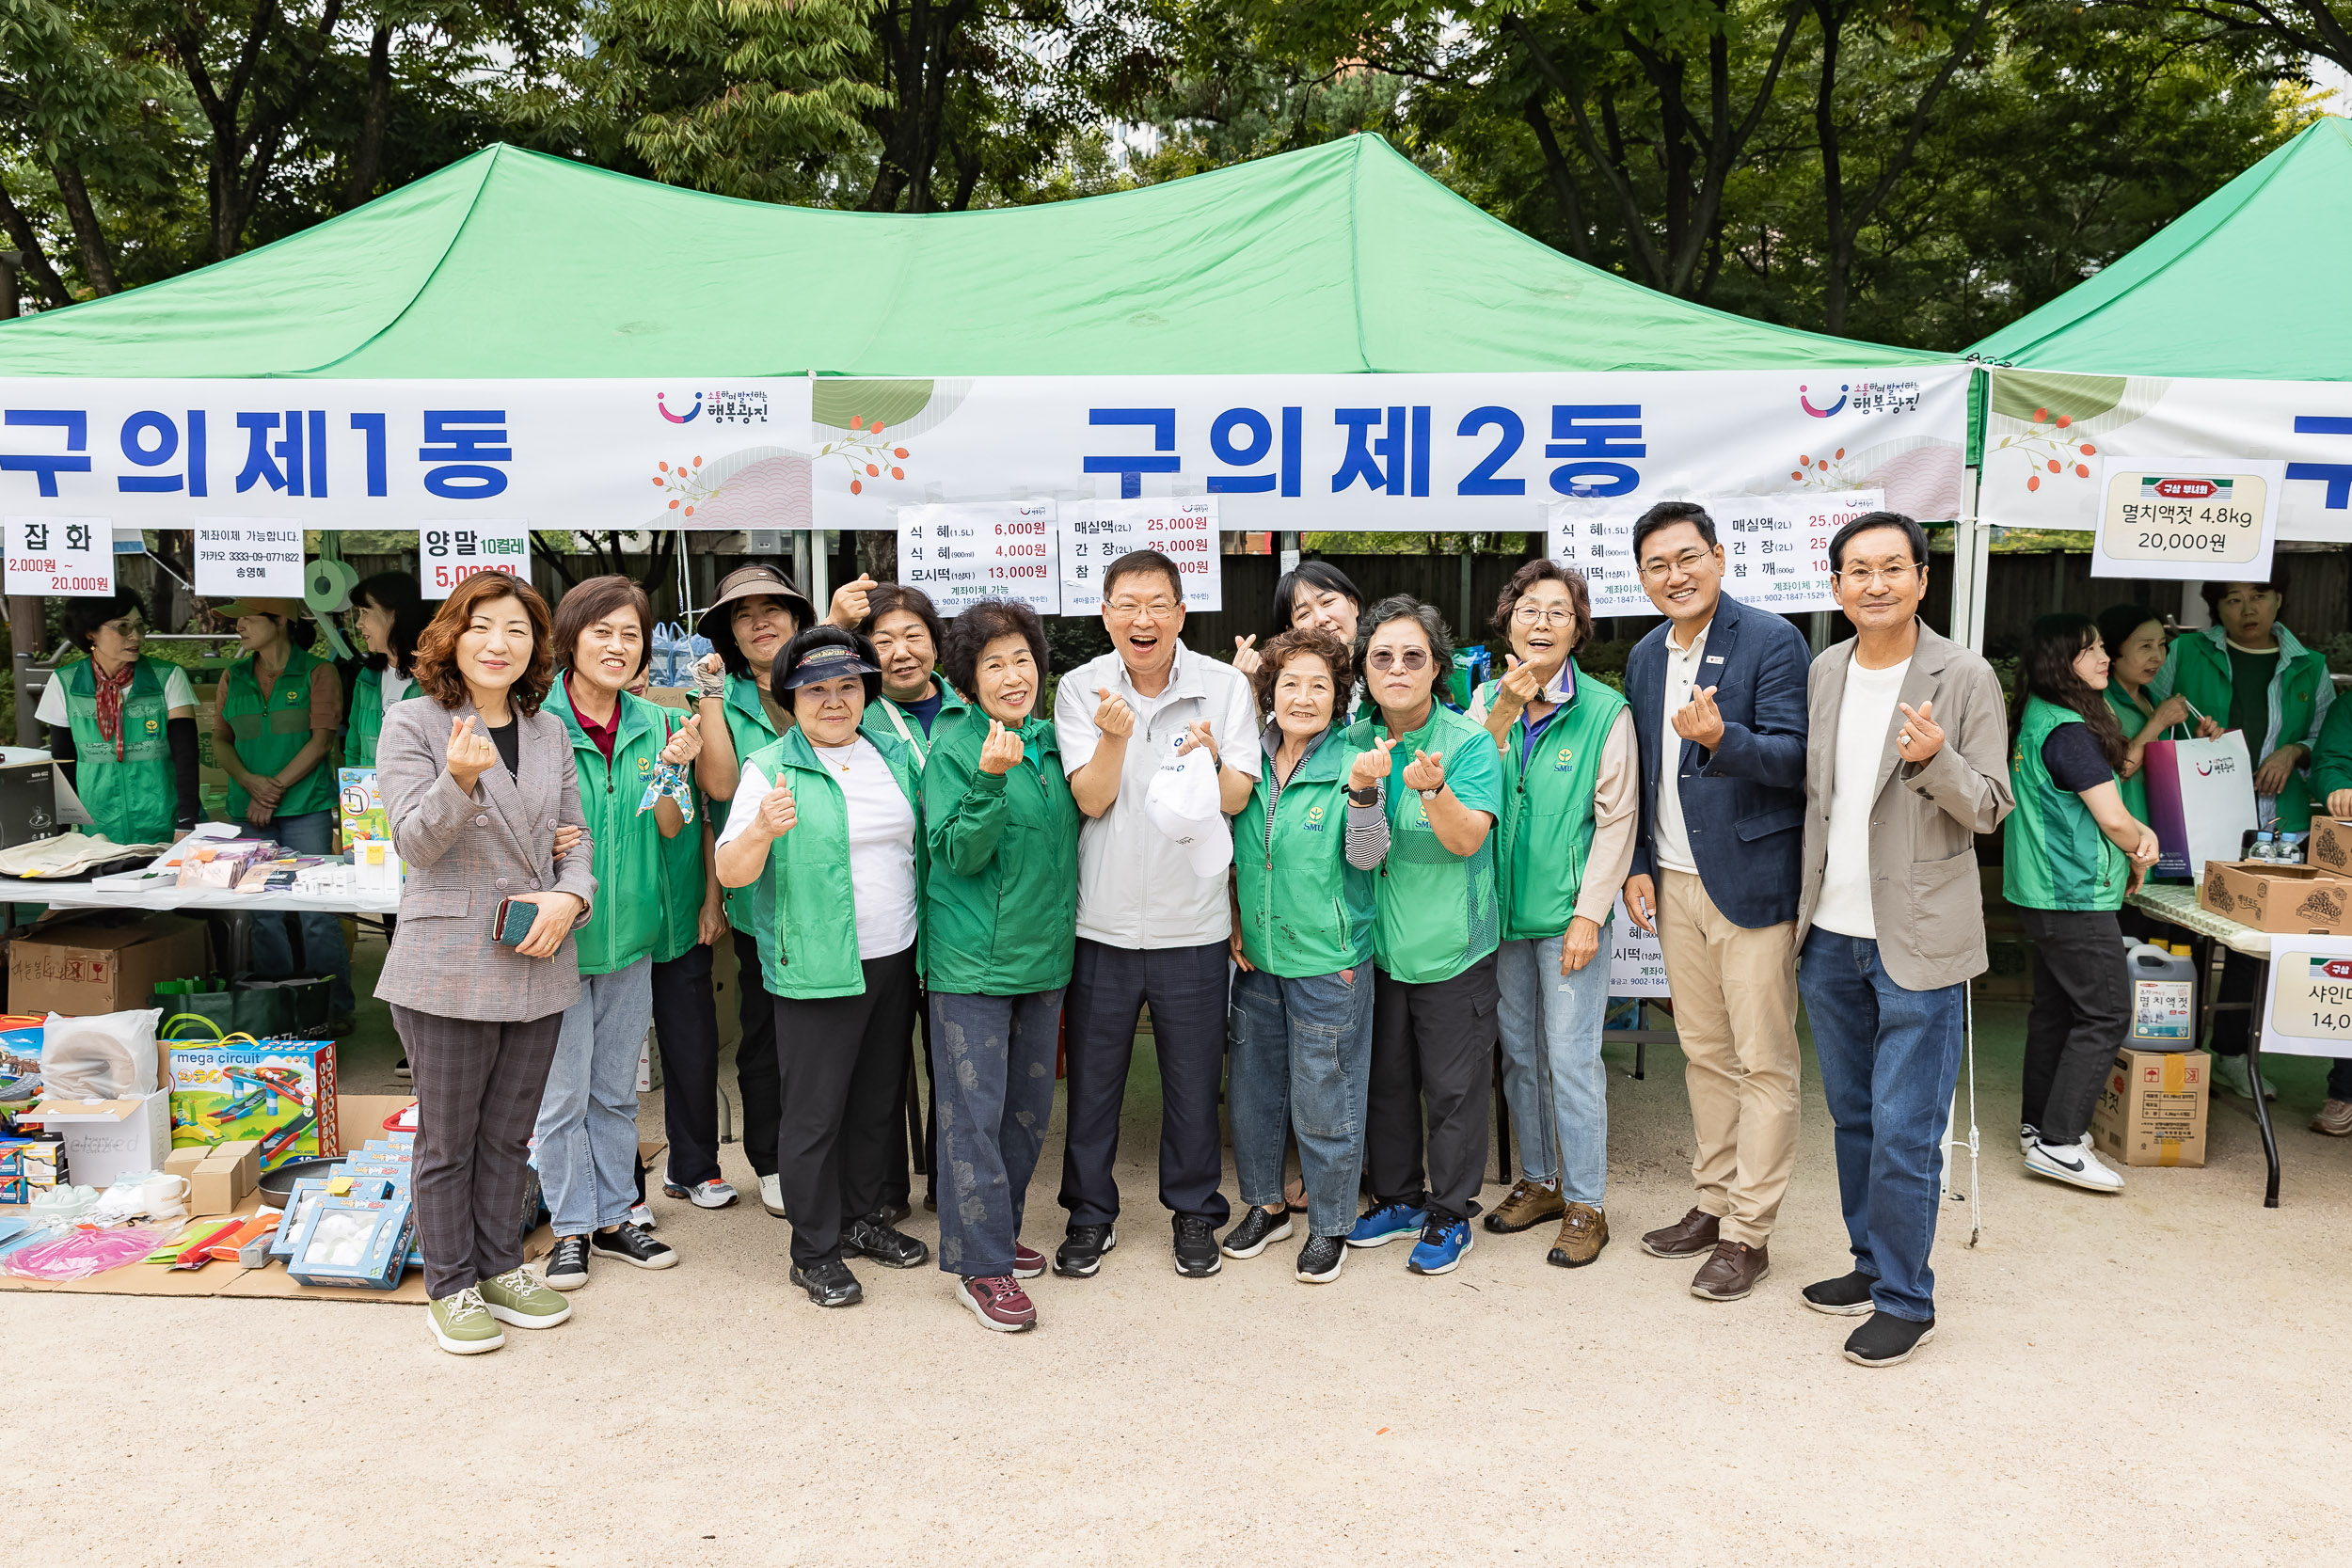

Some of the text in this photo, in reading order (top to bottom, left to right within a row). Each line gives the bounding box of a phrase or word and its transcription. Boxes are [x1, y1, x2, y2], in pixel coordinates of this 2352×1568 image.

[1852, 393, 1919, 415] 행복광진
[707, 403, 768, 424] 행복광진
[0, 410, 513, 499] 구의제1동
[1083, 404, 1647, 499] 구의제2동
[2164, 483, 2208, 495] 구삼 부녀회
[1148, 516, 1207, 531] 25,000원
[2122, 504, 2252, 528] 멸치액젓 4.8kg
[199, 530, 299, 542] 계좌이체 가능합니다.
[994, 521, 1045, 536] 6,000원
[480, 538, 525, 555] 10켤레
[1148, 538, 1208, 554] 25,000원
[2138, 532, 2226, 553] 20,000원
[200, 550, 299, 562] 카카오 3333-09-0771822
[995, 543, 1046, 558] 4,000원
[9, 558, 56, 573] 2,000원
[236, 566, 265, 578] 송영혜
[988, 564, 1047, 579] 13,000원
[436, 564, 516, 589] 5,0
[52, 577, 108, 592] 20,000원
[951, 584, 1009, 595] 계좌이체 가능
[1604, 584, 1643, 594] 계좌이체
[1772, 580, 1811, 591] 계좌이체
[1303, 822, 1324, 832] SMU
[177, 1052, 261, 1066] mega circuit
[65, 1133, 139, 1153] elaxed
